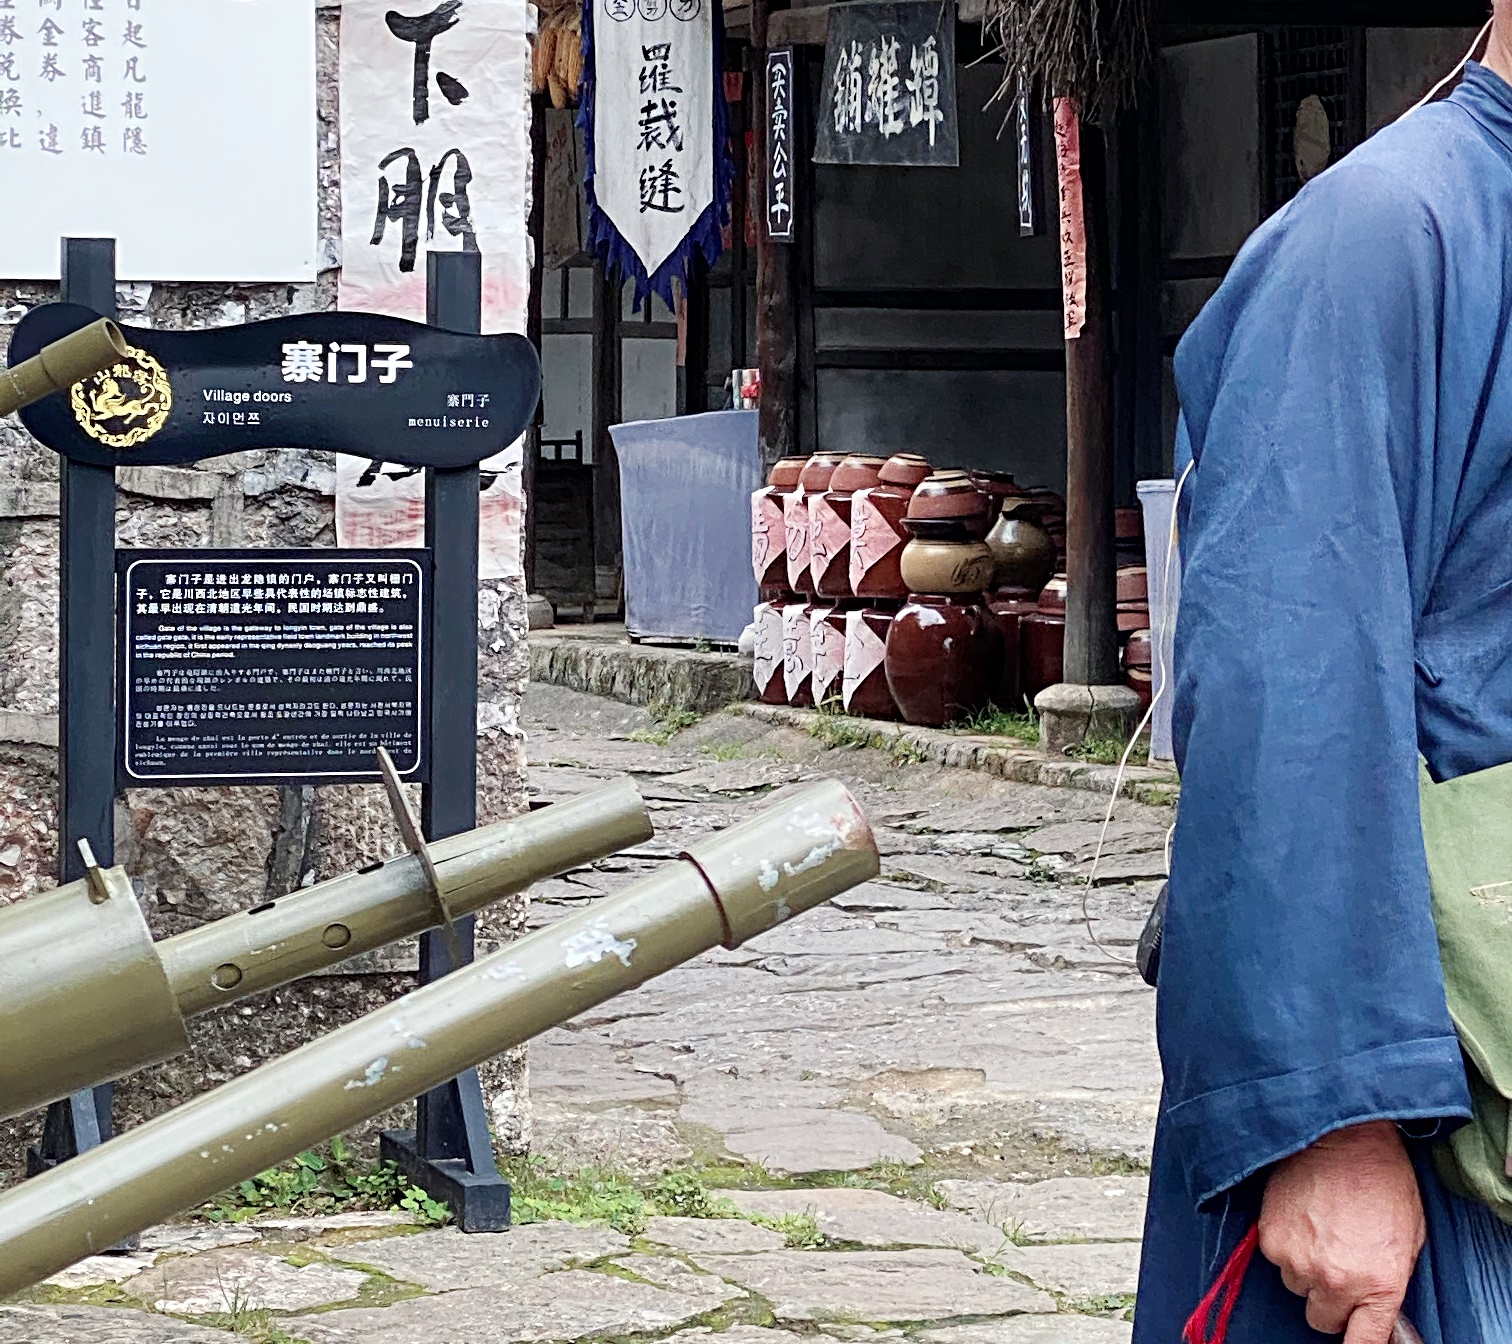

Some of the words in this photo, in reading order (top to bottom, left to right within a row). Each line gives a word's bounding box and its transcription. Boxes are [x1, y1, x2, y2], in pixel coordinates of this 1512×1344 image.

[281, 342, 413, 384] 寨门子
[202, 389, 250, 405] Village
[253, 389, 292, 404] doors
[408, 417, 490, 429] menuiserie
